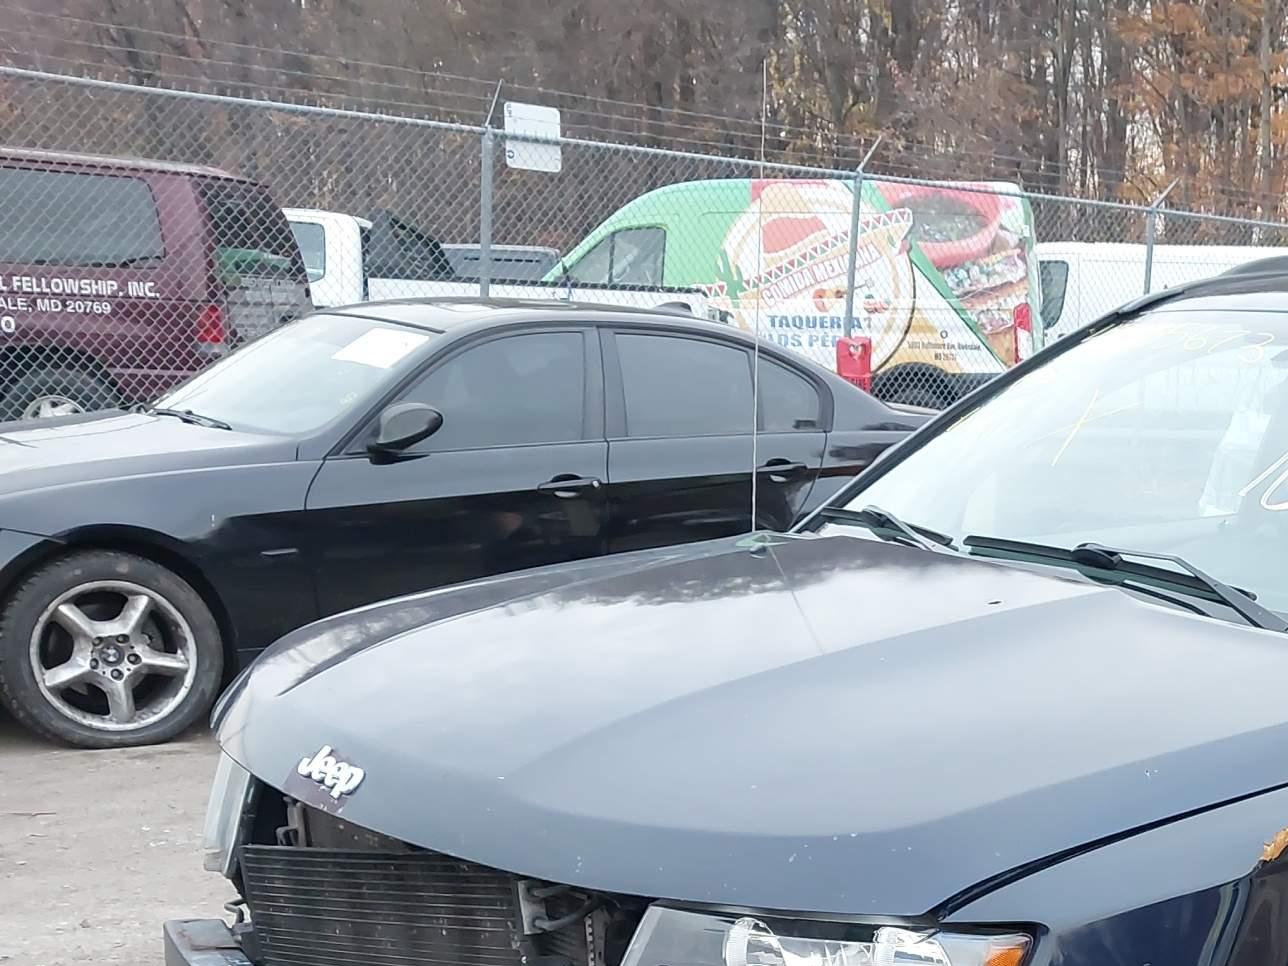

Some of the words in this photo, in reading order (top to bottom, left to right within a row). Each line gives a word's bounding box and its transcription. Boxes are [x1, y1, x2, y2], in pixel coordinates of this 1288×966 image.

[127, 281, 161, 298] INC.
[761, 264, 816, 308] COMIDA
[810, 238, 883, 284] MEXIANA
[36, 298, 63, 312] MD
[65, 300, 112, 315] 20769
[297, 744, 365, 800] Jeep
